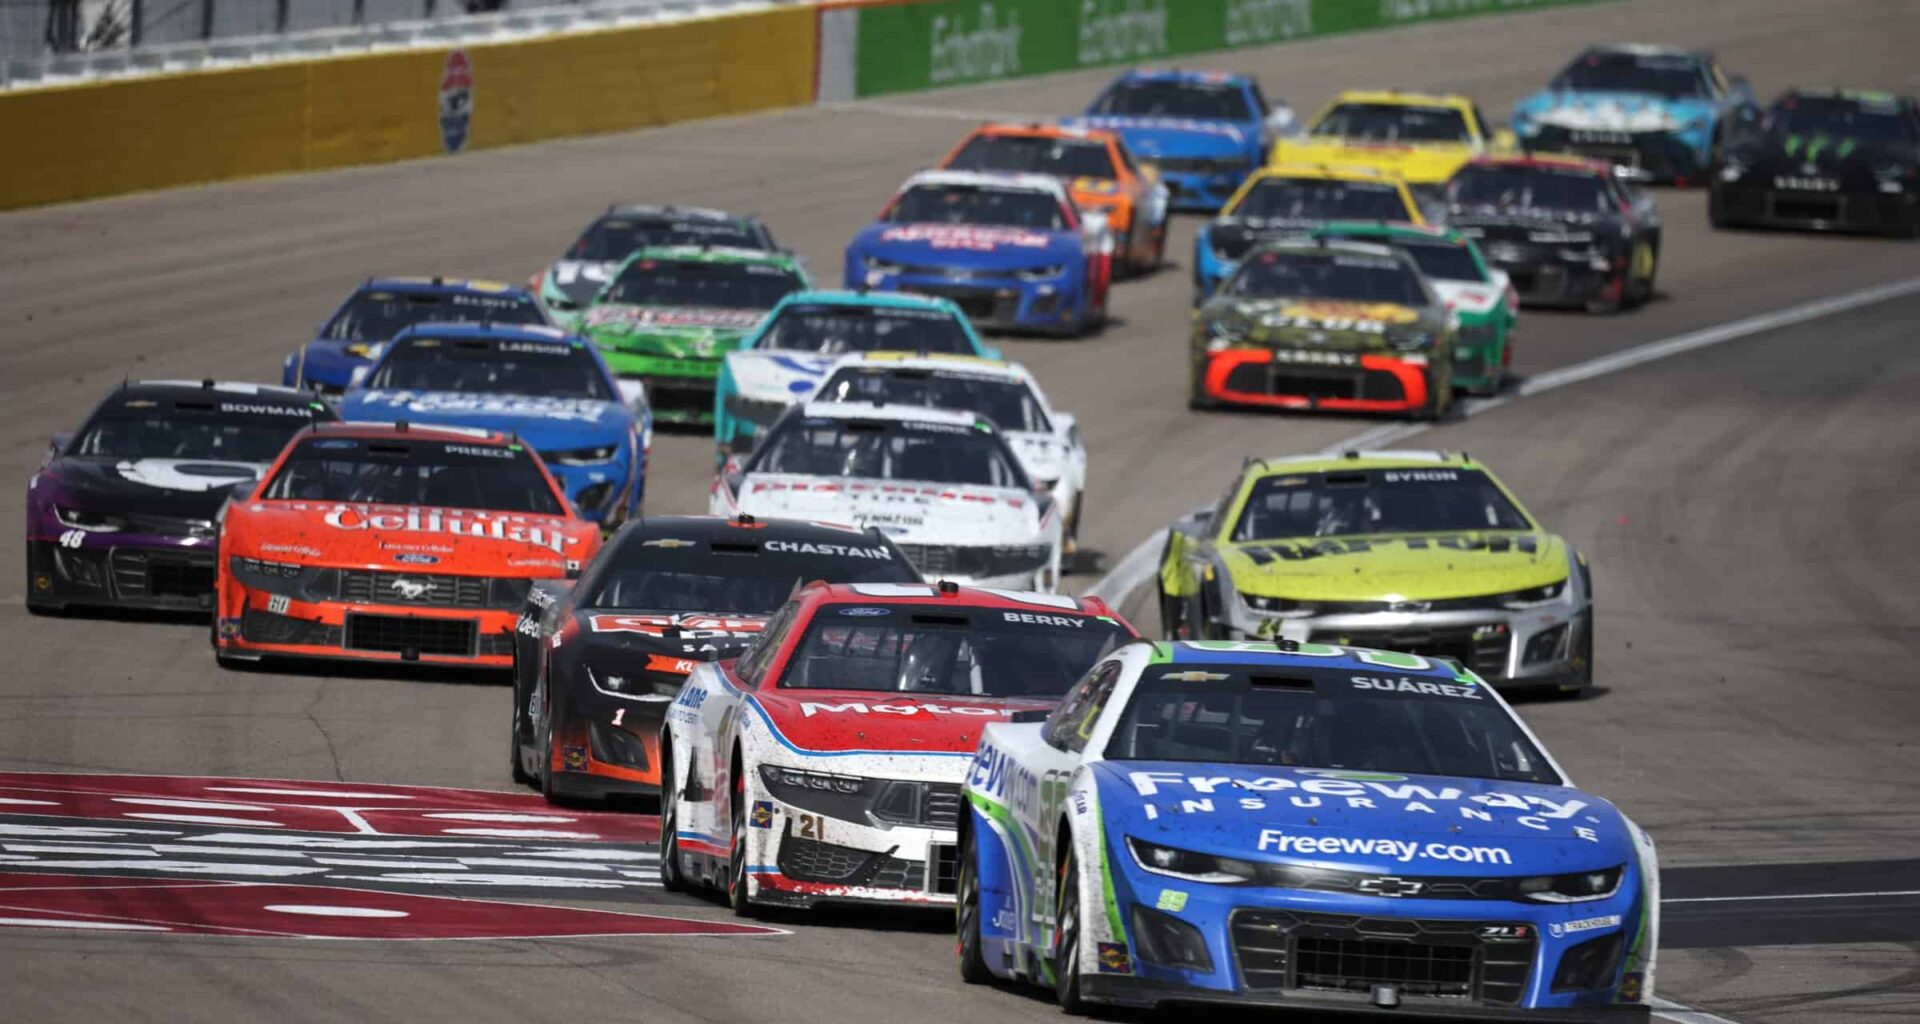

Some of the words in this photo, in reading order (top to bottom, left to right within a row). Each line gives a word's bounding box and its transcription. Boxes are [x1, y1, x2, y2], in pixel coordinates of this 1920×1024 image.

[499, 342, 570, 356] LARSON
[221, 402, 312, 417] BOWMAN
[445, 445, 515, 458] PREECE
[1385, 470, 1458, 483] BYRON
[59, 530, 86, 548] 48
[324, 504, 580, 554] Cellular
[764, 539, 892, 562] CHASTAIN
[268, 595, 291, 614] 60
[1003, 612, 1085, 629] BERRY
[1350, 675, 1483, 700] SUÁREZ
[611, 708, 626, 726] 1
[1128, 771, 1588, 820] Freeway
[800, 814, 824, 841] 21
[1144, 796, 1600, 844] INSURANCE
[1259, 829, 1513, 865] Freeway.com
[1156, 888, 1189, 912] 99
